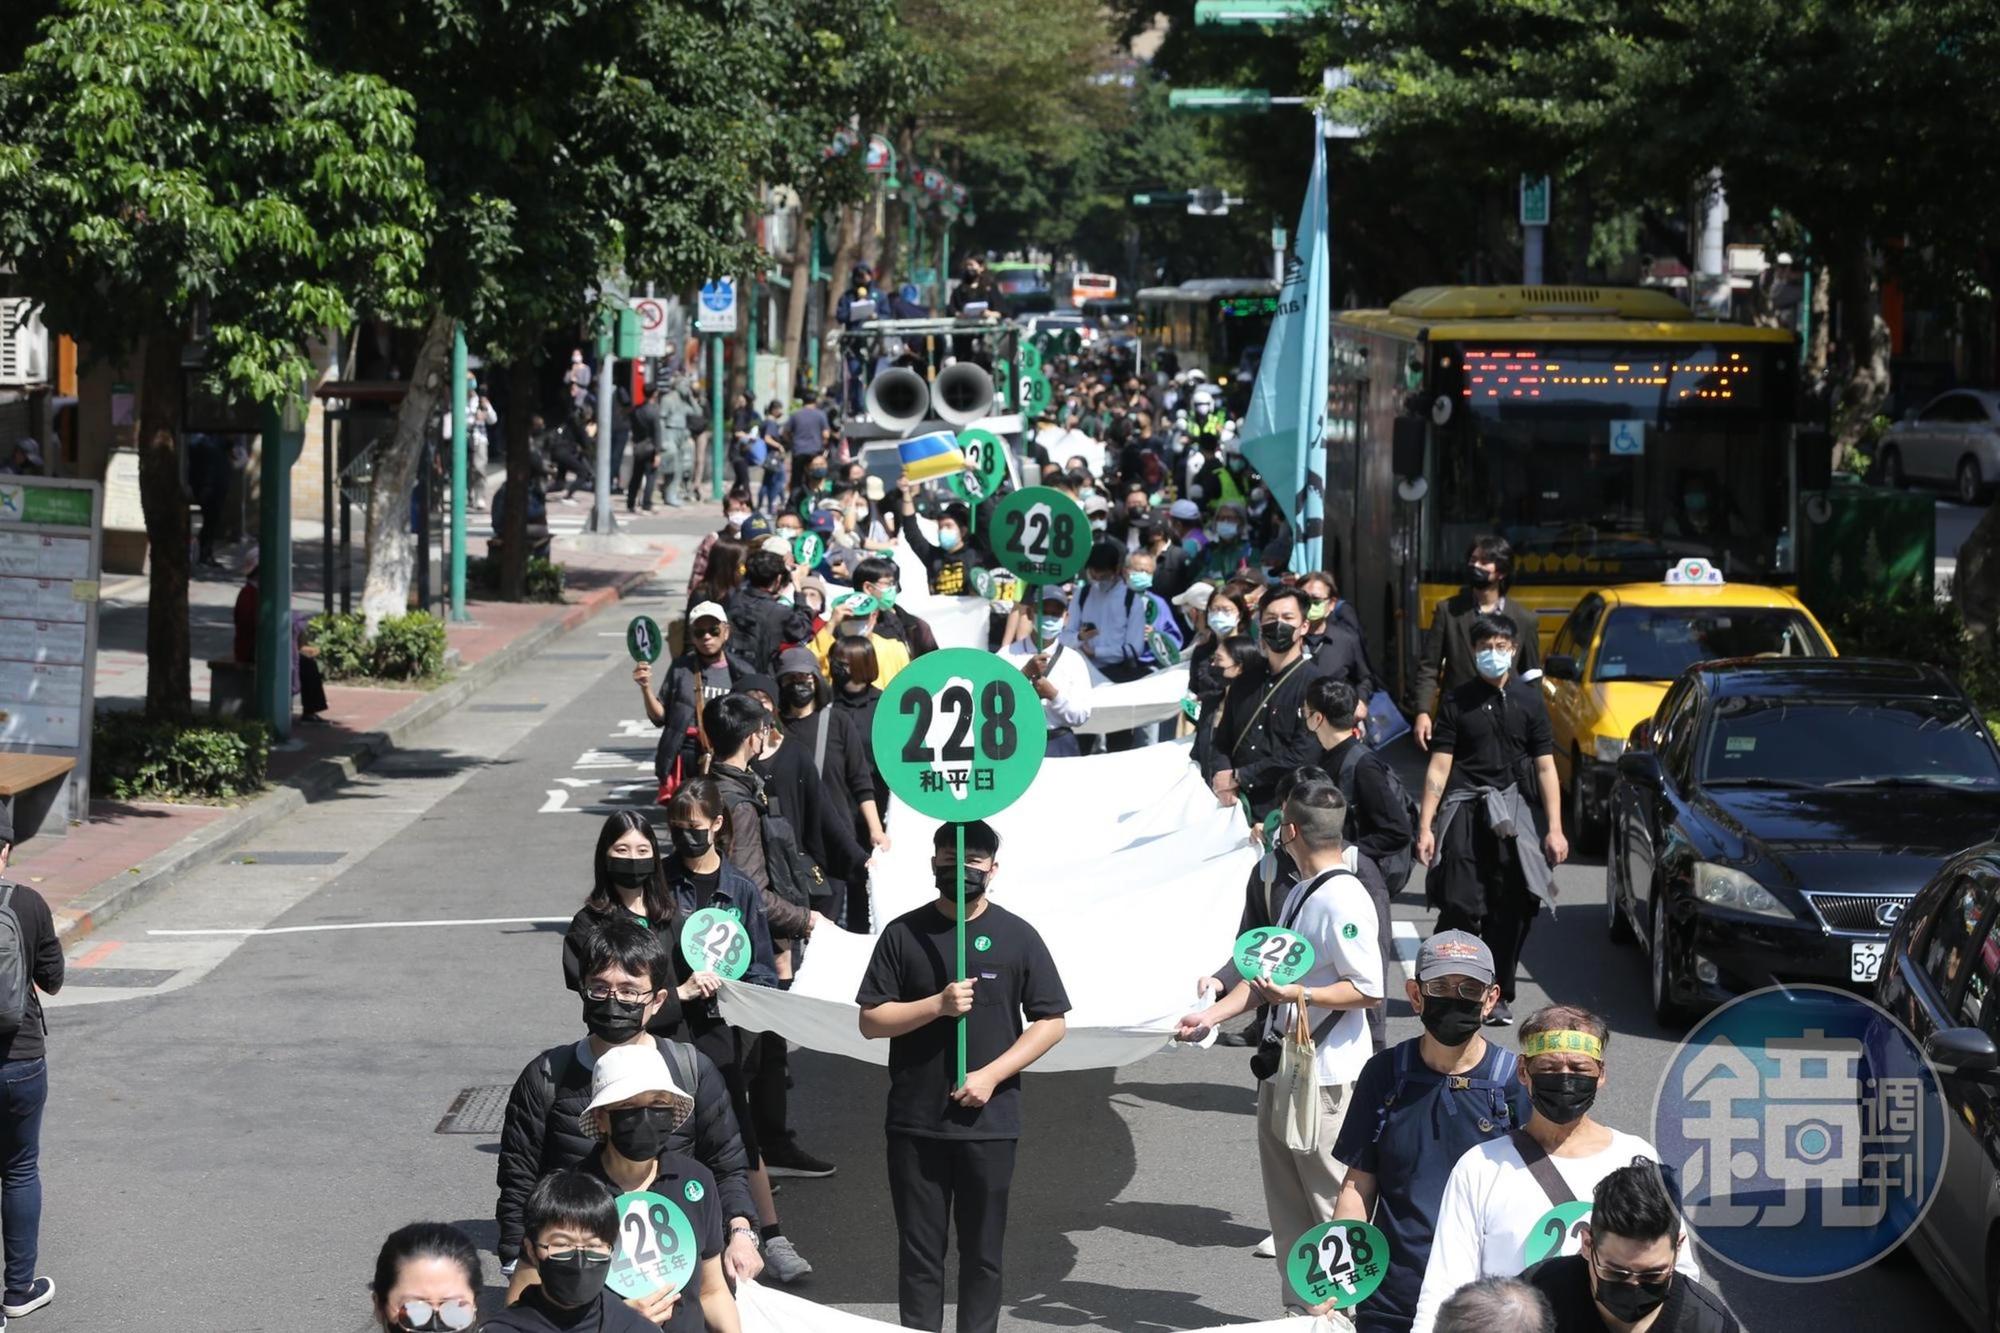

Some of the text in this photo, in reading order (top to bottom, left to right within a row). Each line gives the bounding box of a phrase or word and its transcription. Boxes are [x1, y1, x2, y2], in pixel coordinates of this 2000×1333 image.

[1005, 508, 1075, 559] 228
[898, 680, 1018, 762] 228
[919, 768, 995, 792] 和平日
[691, 913, 745, 966] 228
[1243, 931, 1307, 967] 228
[688, 942, 735, 977] 七十五年
[1241, 955, 1296, 977] 七十五年
[1853, 952, 1884, 976] 52
[618, 1254, 689, 1288] 七十五年
[1298, 1226, 1374, 1286] 228
[1311, 1263, 1380, 1298] 七十五年
